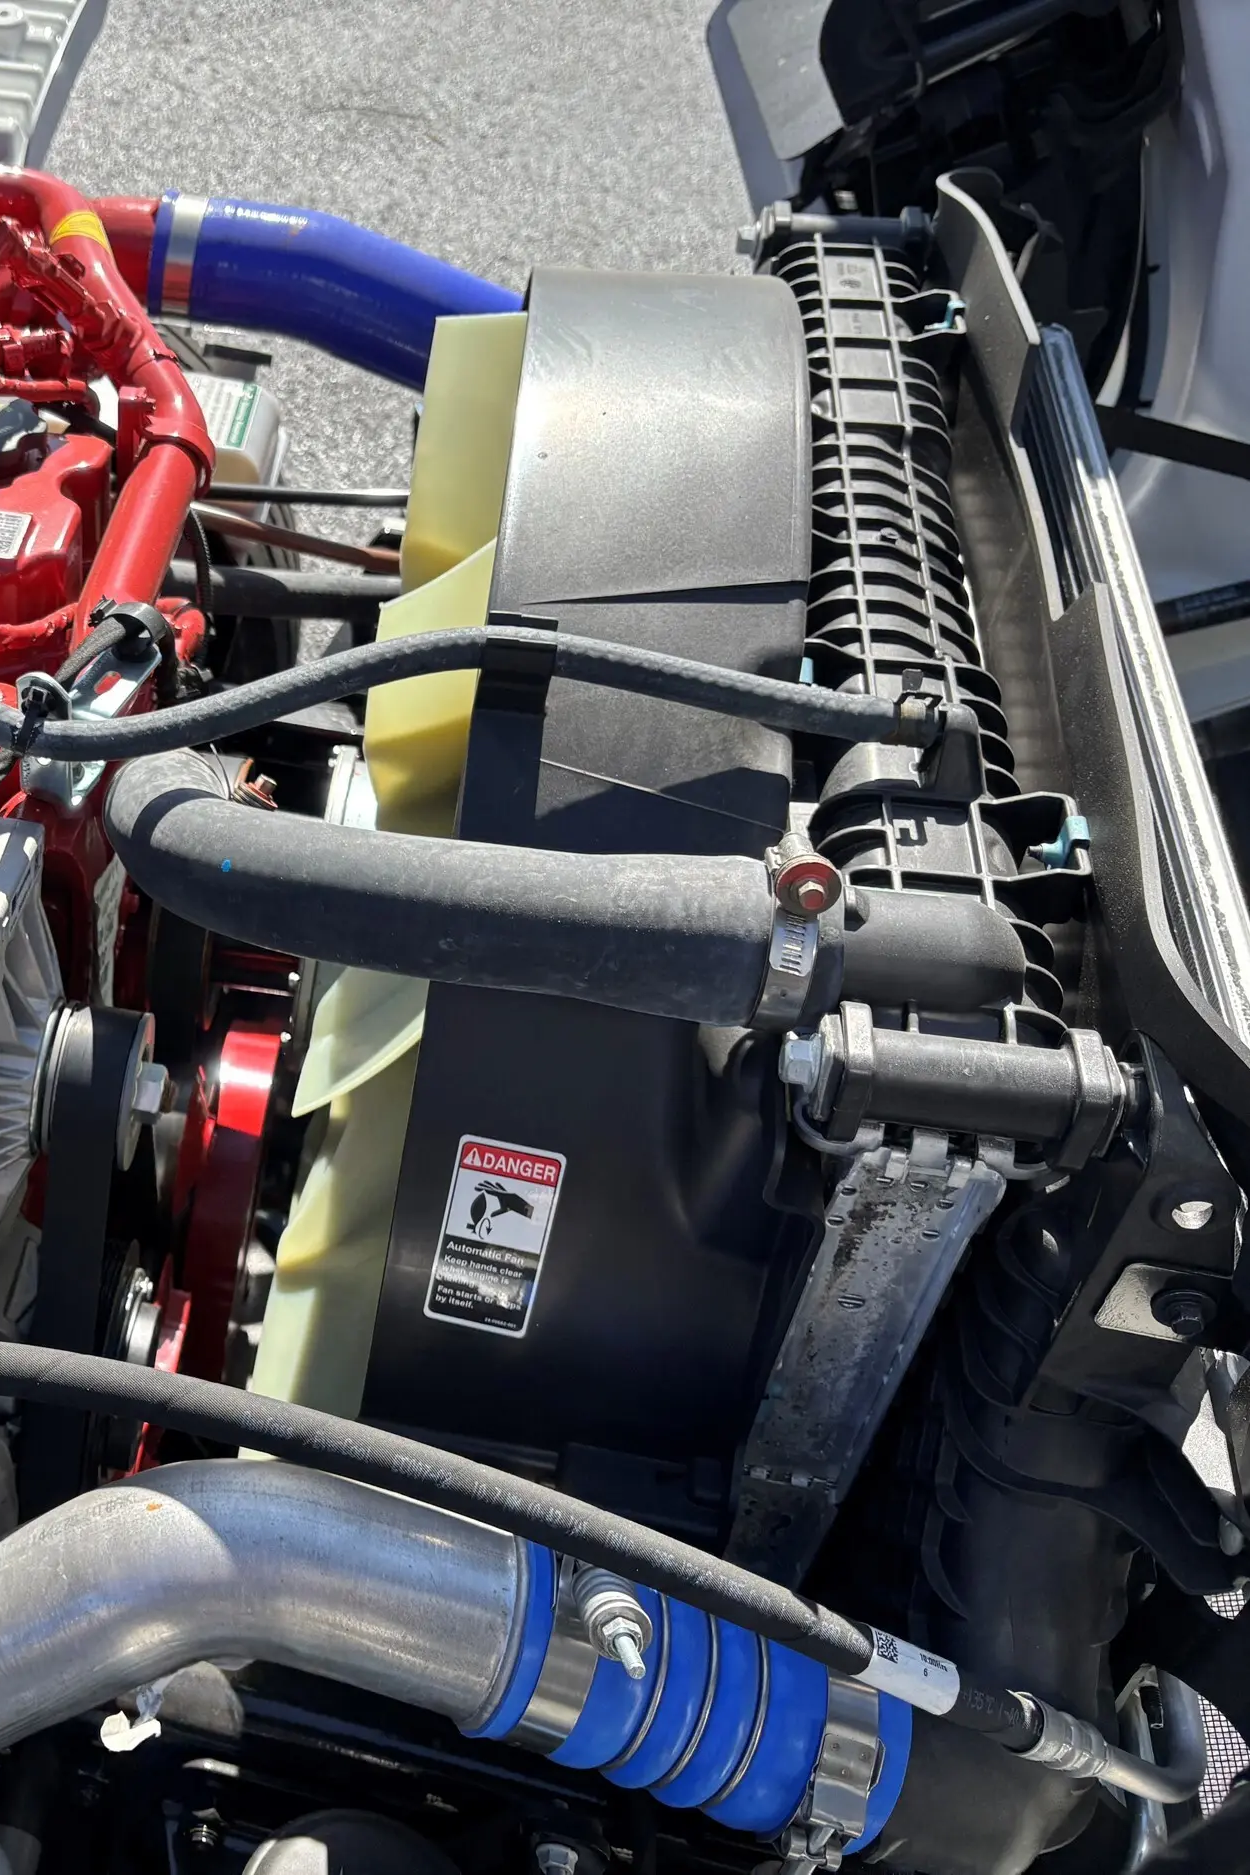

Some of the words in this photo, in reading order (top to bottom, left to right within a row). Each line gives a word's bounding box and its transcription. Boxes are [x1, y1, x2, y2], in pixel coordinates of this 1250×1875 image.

[482, 1152, 556, 1182] DANGER
[446, 1240, 502, 1260] Automatic
[504, 1253, 524, 1266] Fan
[442, 1264, 466, 1275] when
[468, 1270, 499, 1283] engine
[501, 1276, 509, 1285] is
[444, 1254, 467, 1267] Keep
[469, 1260, 497, 1273] hands
[499, 1267, 523, 1279] clear
[435, 1294, 446, 1304] by
[448, 1296, 474, 1309] itself.
[437, 1284, 454, 1296] Fan
[455, 1288, 482, 1302] starts
